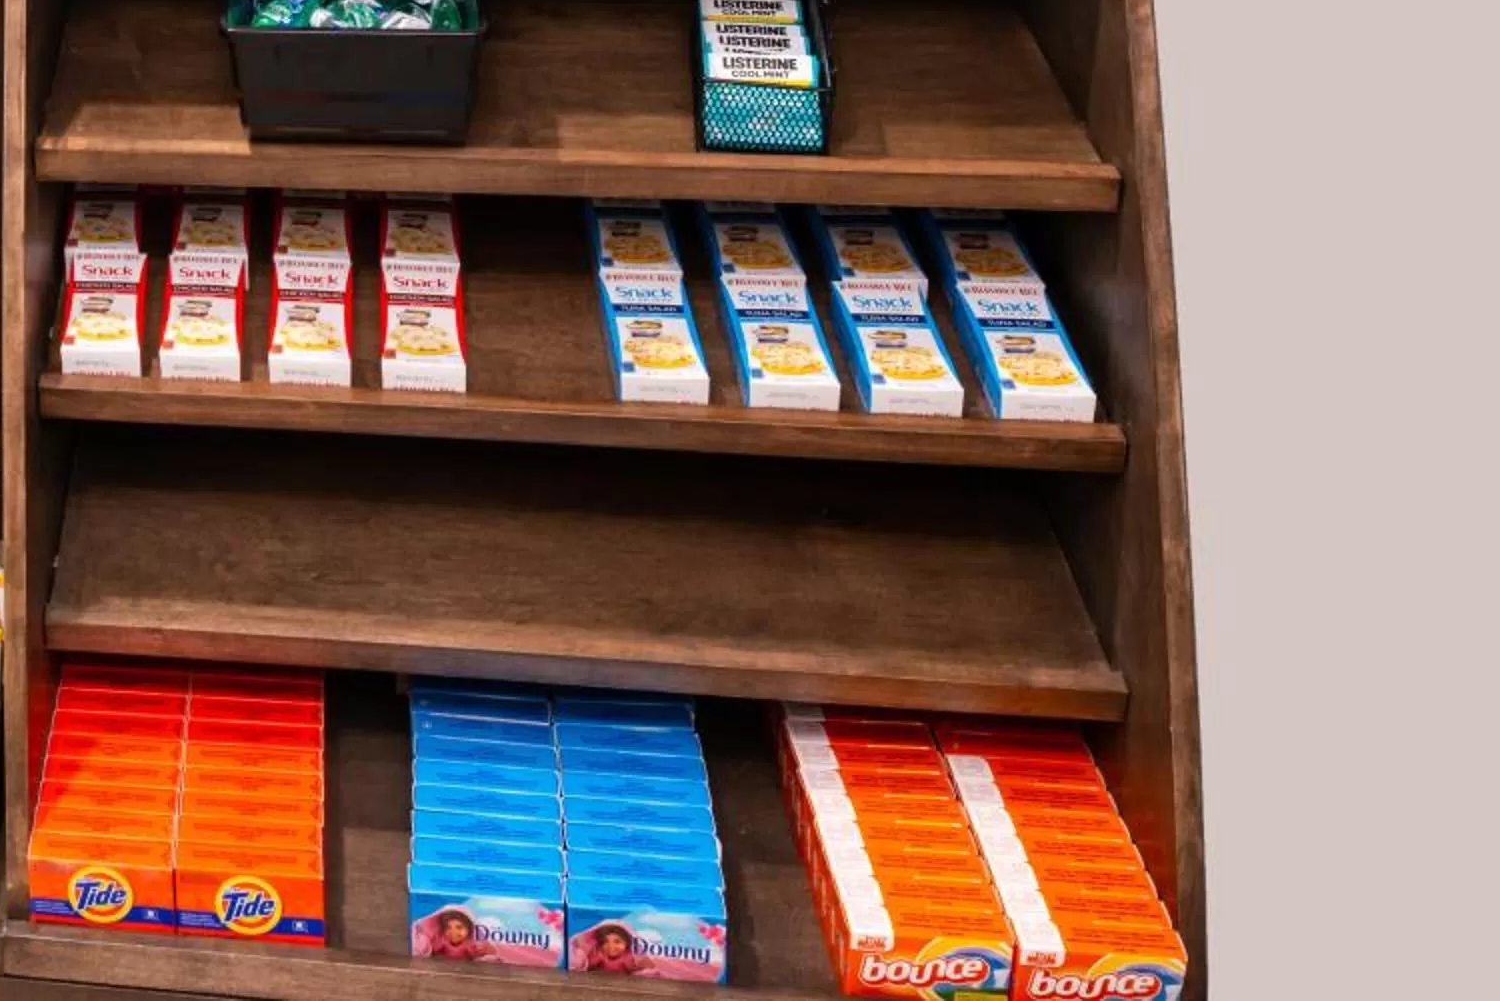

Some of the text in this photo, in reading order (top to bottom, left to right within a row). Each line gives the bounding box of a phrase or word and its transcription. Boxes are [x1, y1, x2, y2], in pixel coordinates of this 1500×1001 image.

[713, 0, 784, 12] LISTERINE
[716, 24, 787, 36] LISTERINE
[719, 36, 792, 49] LISTERINE
[723, 56, 799, 71] LISTERINE
[731, 70, 791, 80] COOL MINT
[82, 264, 133, 277] Snack
[179, 267, 232, 281] Snack
[285, 271, 339, 286] Snack
[392, 275, 449, 290] Snack
[616, 286, 673, 299] Snack
[739, 290, 799, 304] Snack
[852, 295, 913, 308] Snack
[978, 299, 1038, 313] Snack
[75, 880, 128, 910] Tide
[222, 892, 275, 923] Tide
[474, 924, 550, 950] Downy
[632, 937, 711, 965] Downy
[861, 954, 986, 985] bounce
[1030, 970, 1158, 1000] bounce
